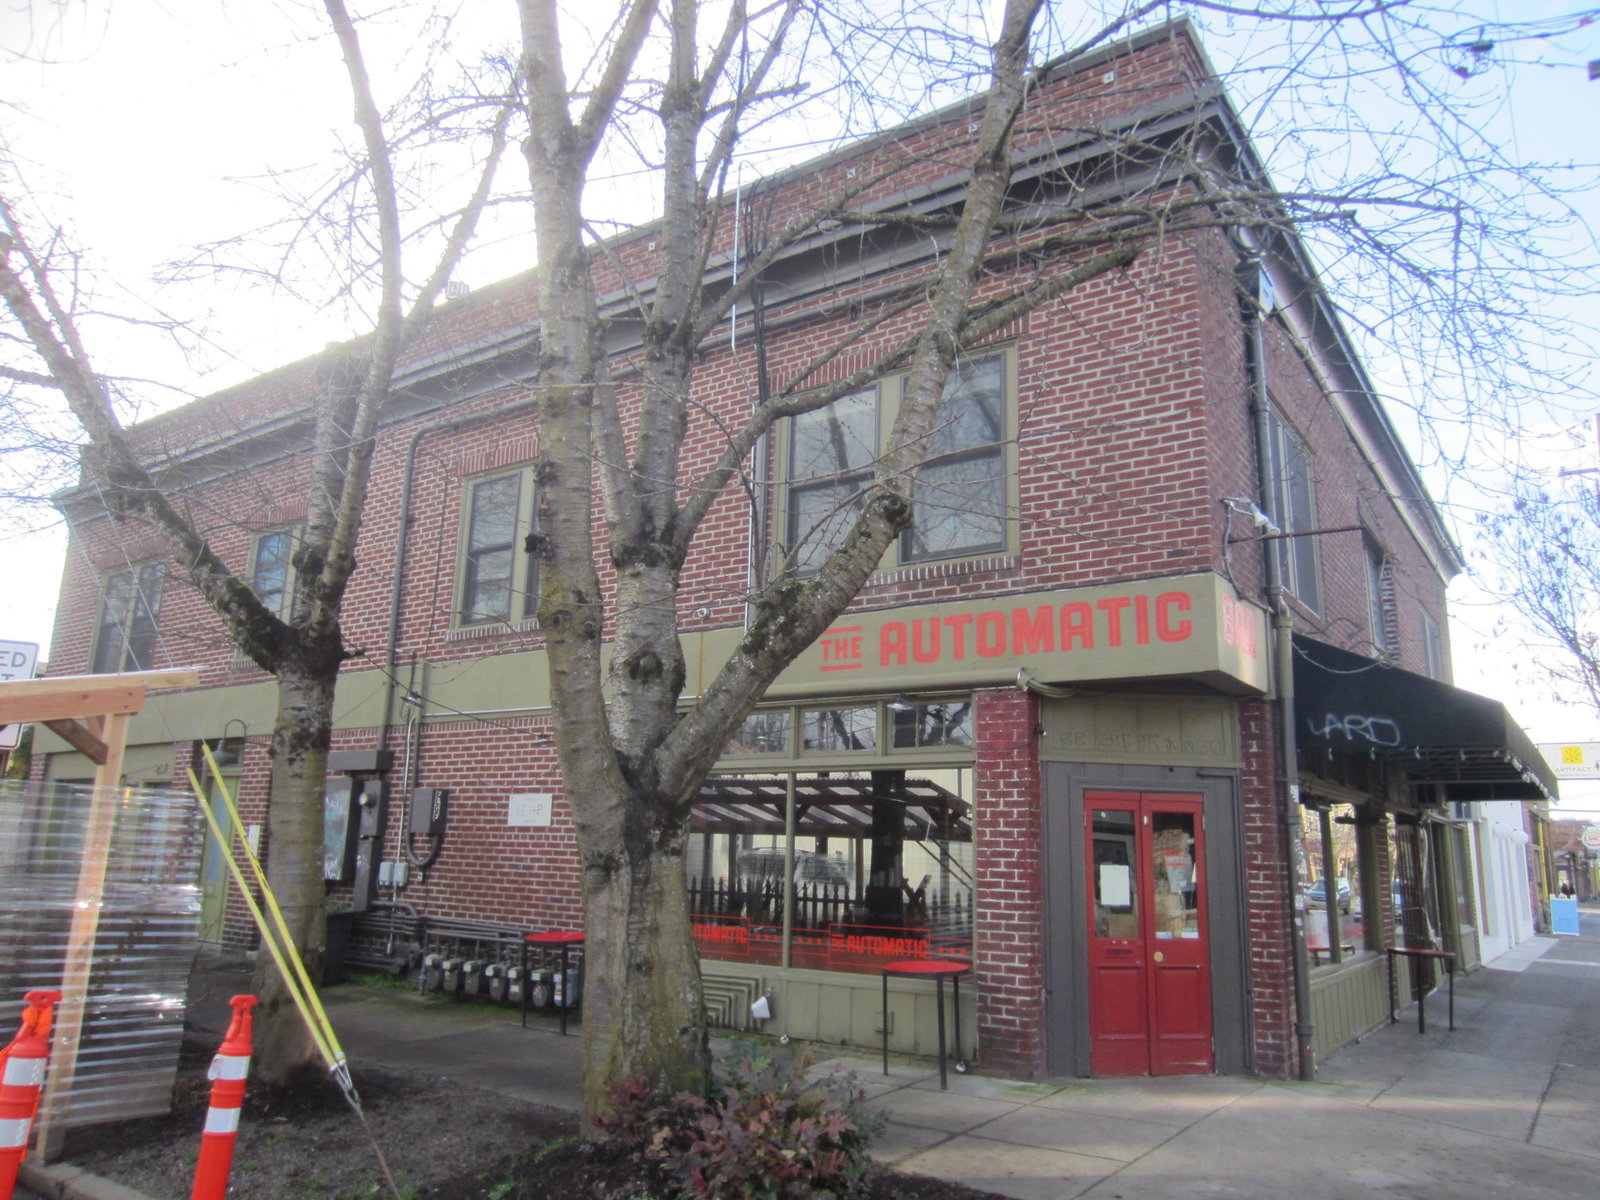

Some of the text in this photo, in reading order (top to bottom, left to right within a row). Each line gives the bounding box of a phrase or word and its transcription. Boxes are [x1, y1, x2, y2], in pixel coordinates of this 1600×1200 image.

[819, 591, 1192, 666] THE AUTOMATIC
[1222, 594, 1257, 659] BAR
[848, 934, 929, 959] AUTOMATIC
